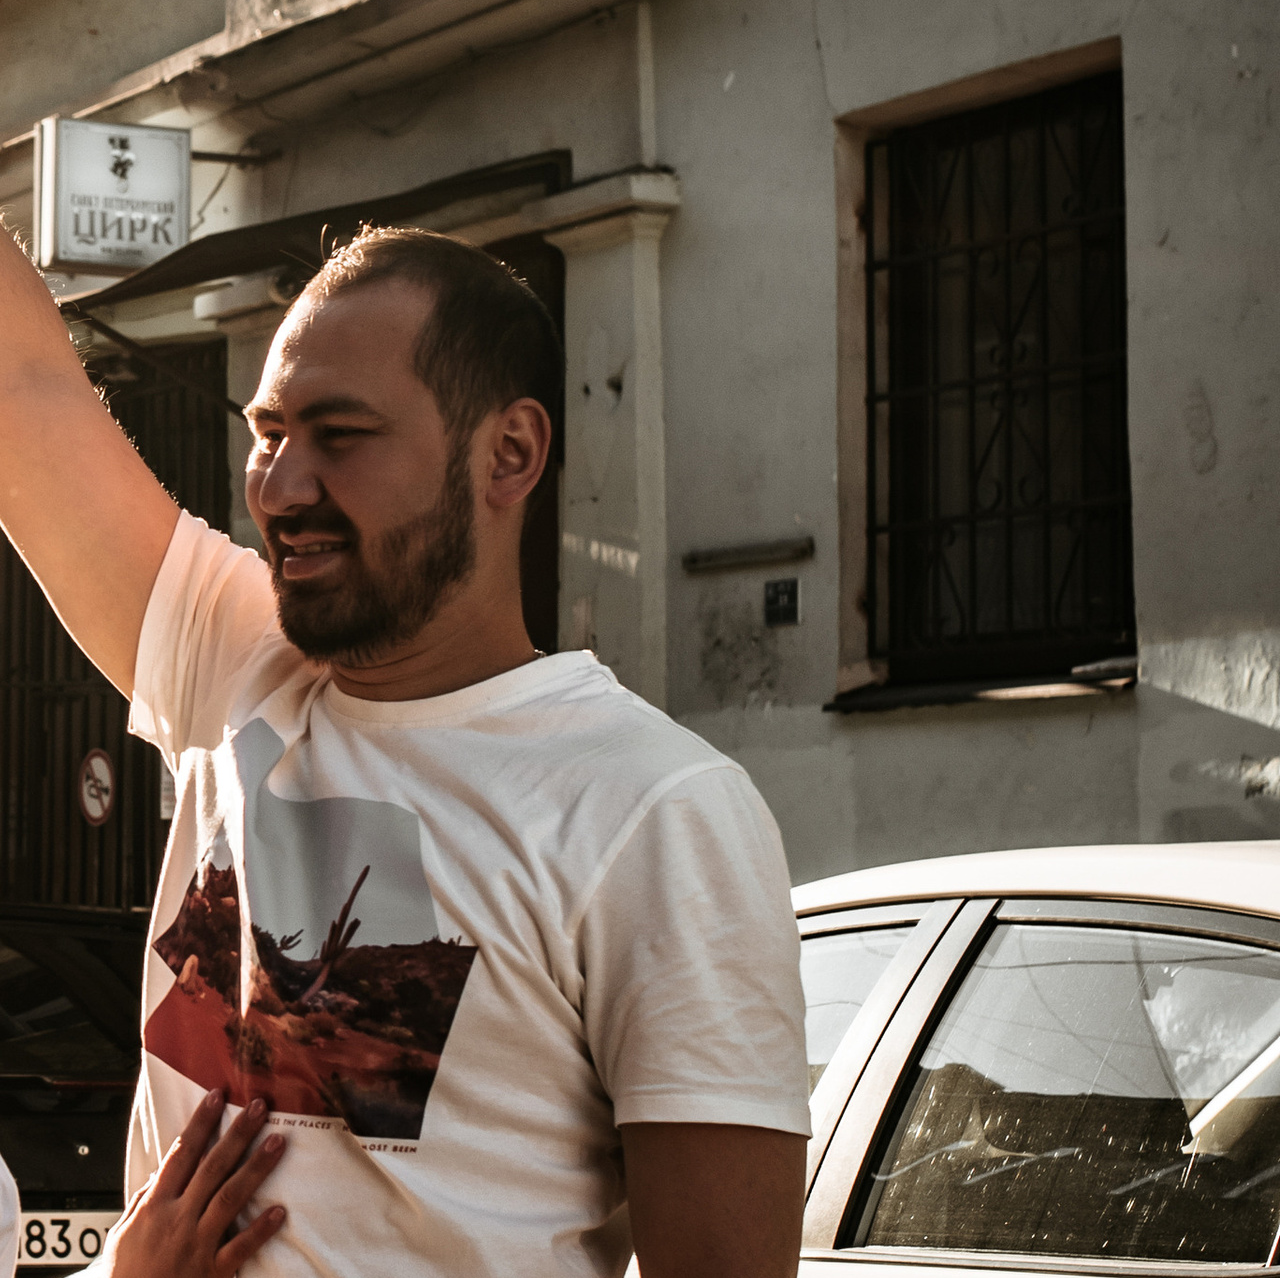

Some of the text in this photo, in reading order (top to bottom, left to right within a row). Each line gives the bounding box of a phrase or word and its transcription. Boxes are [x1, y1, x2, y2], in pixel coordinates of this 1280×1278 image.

[73, 210, 173, 246] ЦИРК
[299, 1119, 332, 1130] PLACES
[392, 1144, 418, 1153] BEEN
